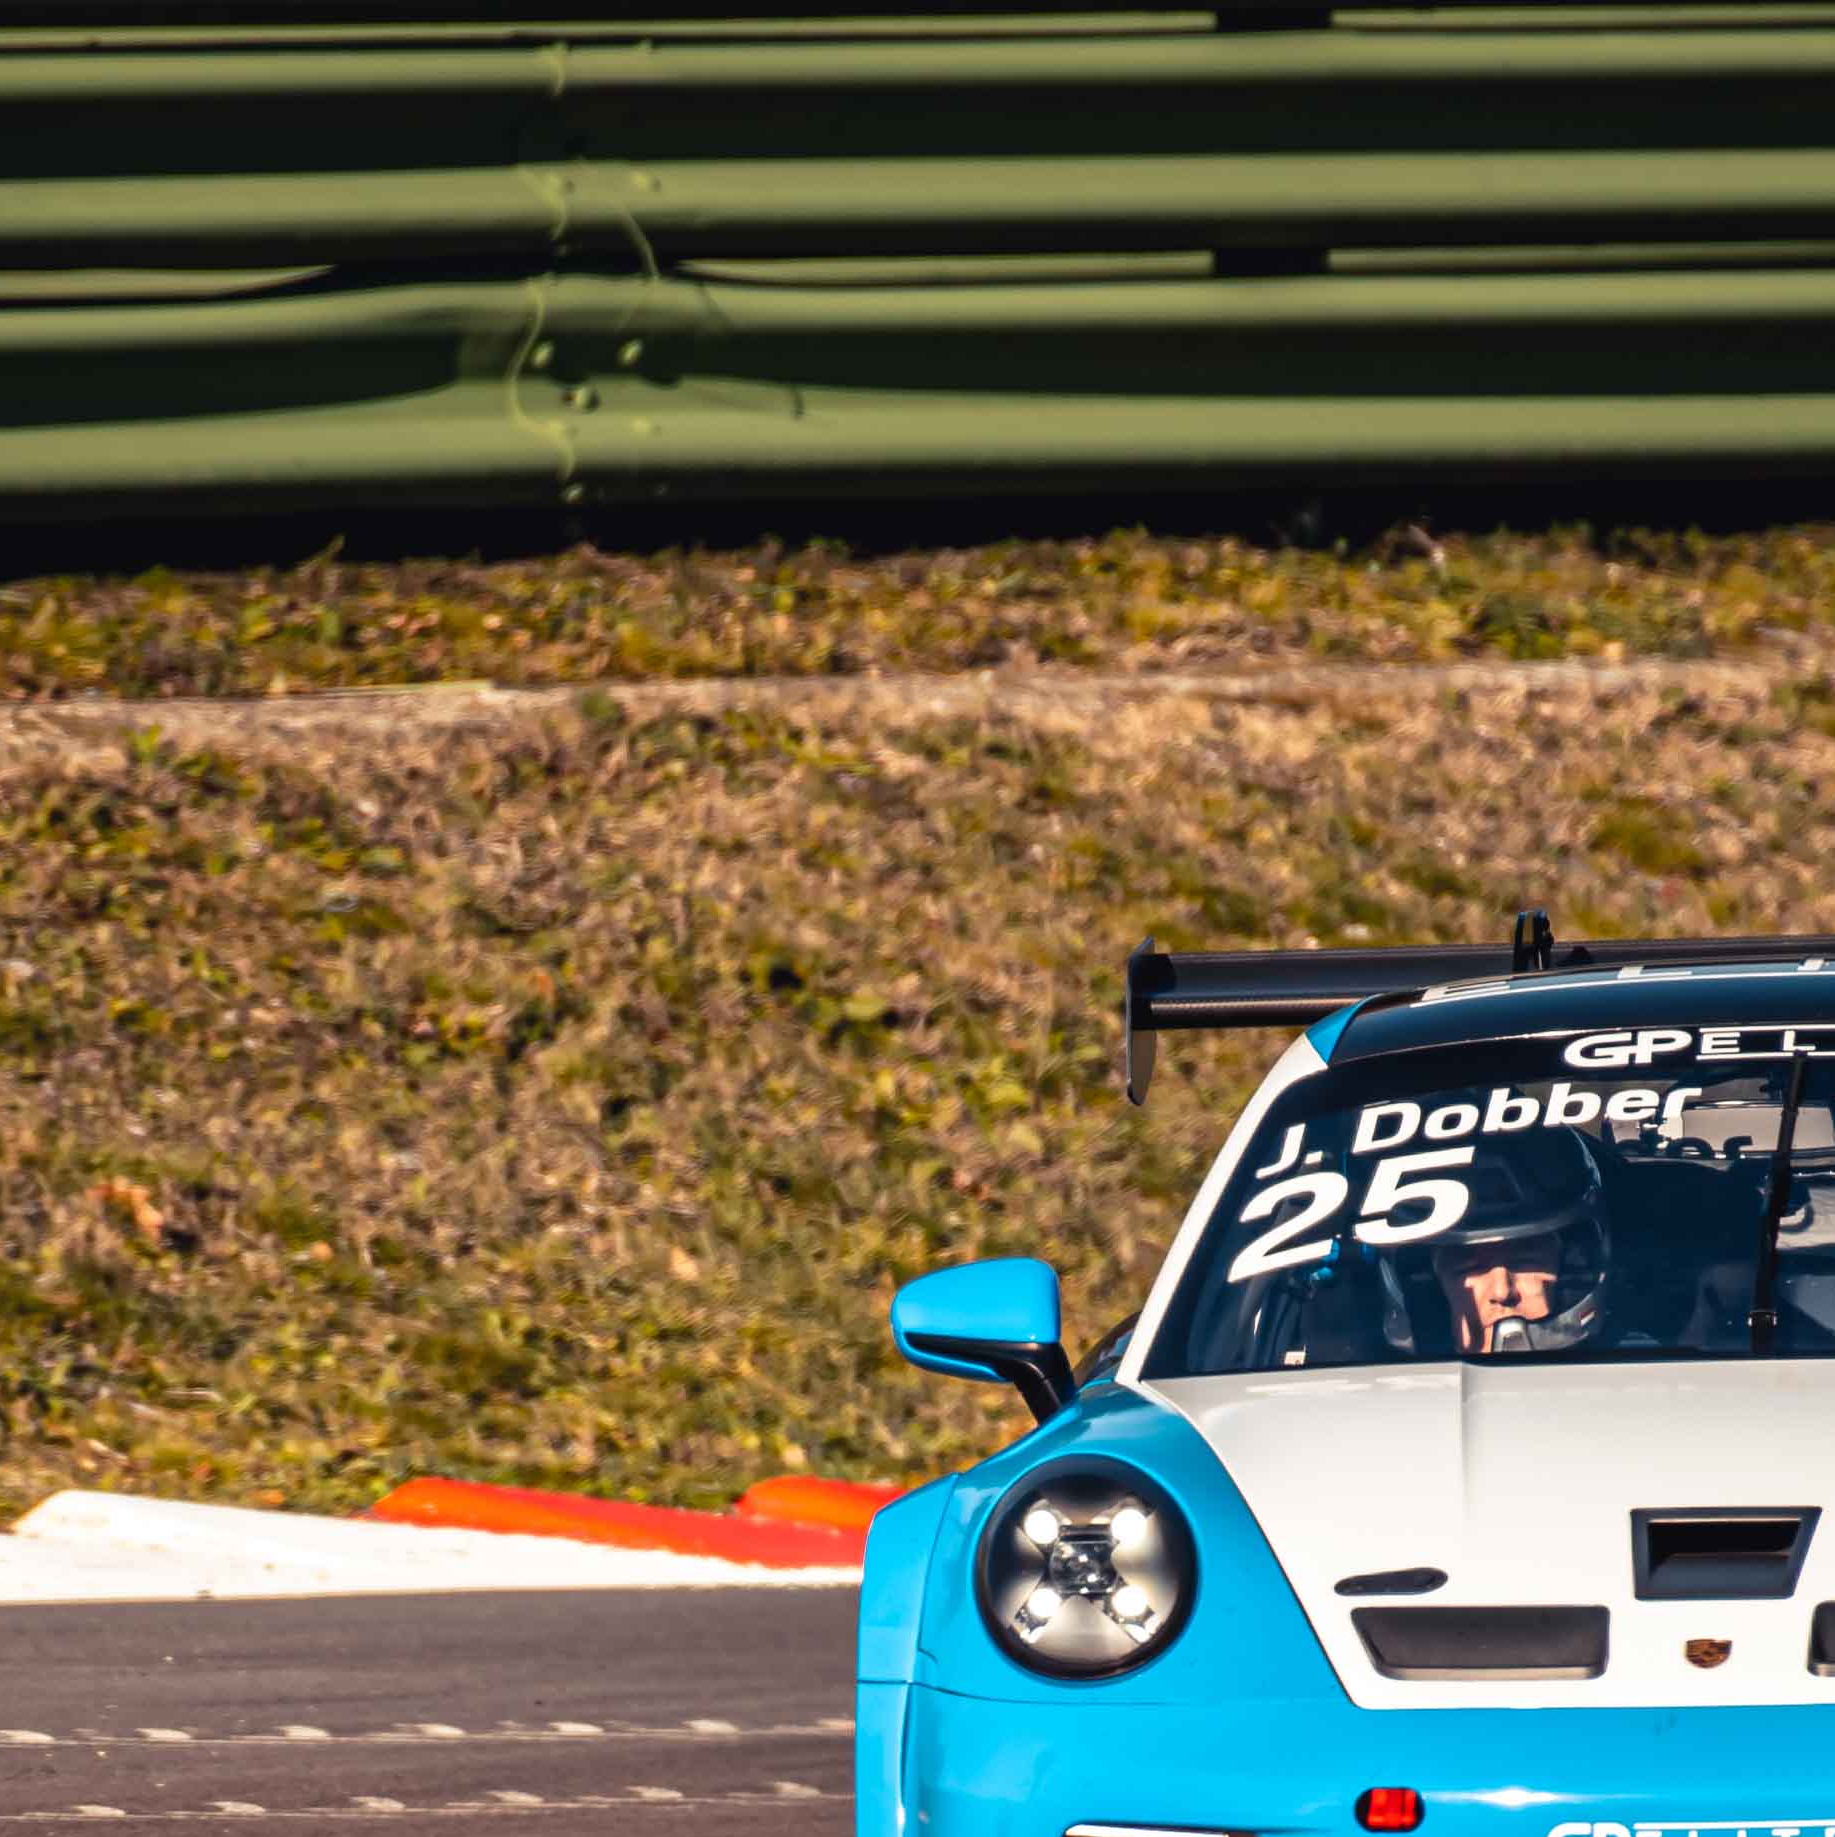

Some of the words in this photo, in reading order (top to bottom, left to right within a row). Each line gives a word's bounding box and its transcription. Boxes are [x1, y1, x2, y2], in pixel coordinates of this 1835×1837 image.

[1256, 1123, 1323, 1179] J.
[1352, 1082, 1702, 1154] Dobber
[1227, 1146, 1475, 1283] 25
